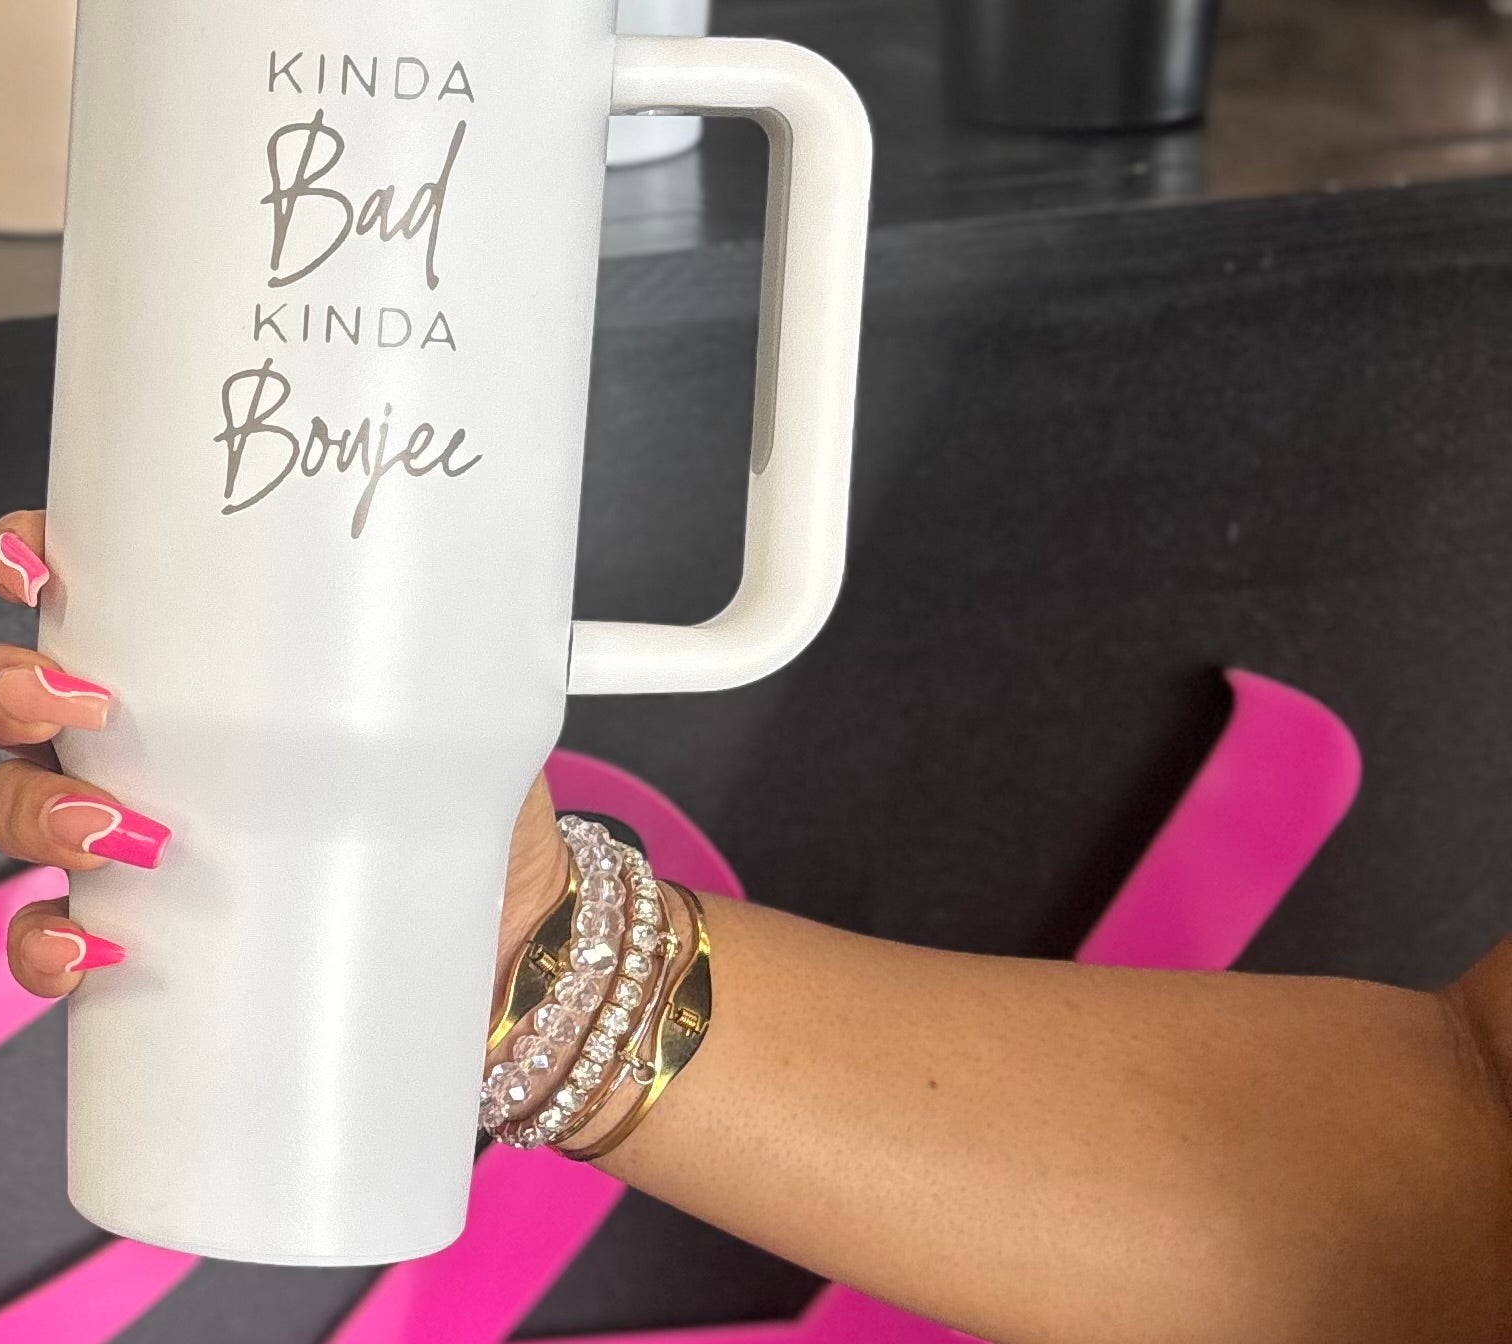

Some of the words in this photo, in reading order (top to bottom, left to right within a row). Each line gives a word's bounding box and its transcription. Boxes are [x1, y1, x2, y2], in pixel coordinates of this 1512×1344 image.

[268, 50, 475, 103] KINDA
[260, 108, 466, 290] Bad
[253, 303, 457, 352] KINDA
[212, 357, 483, 540] Boujee
